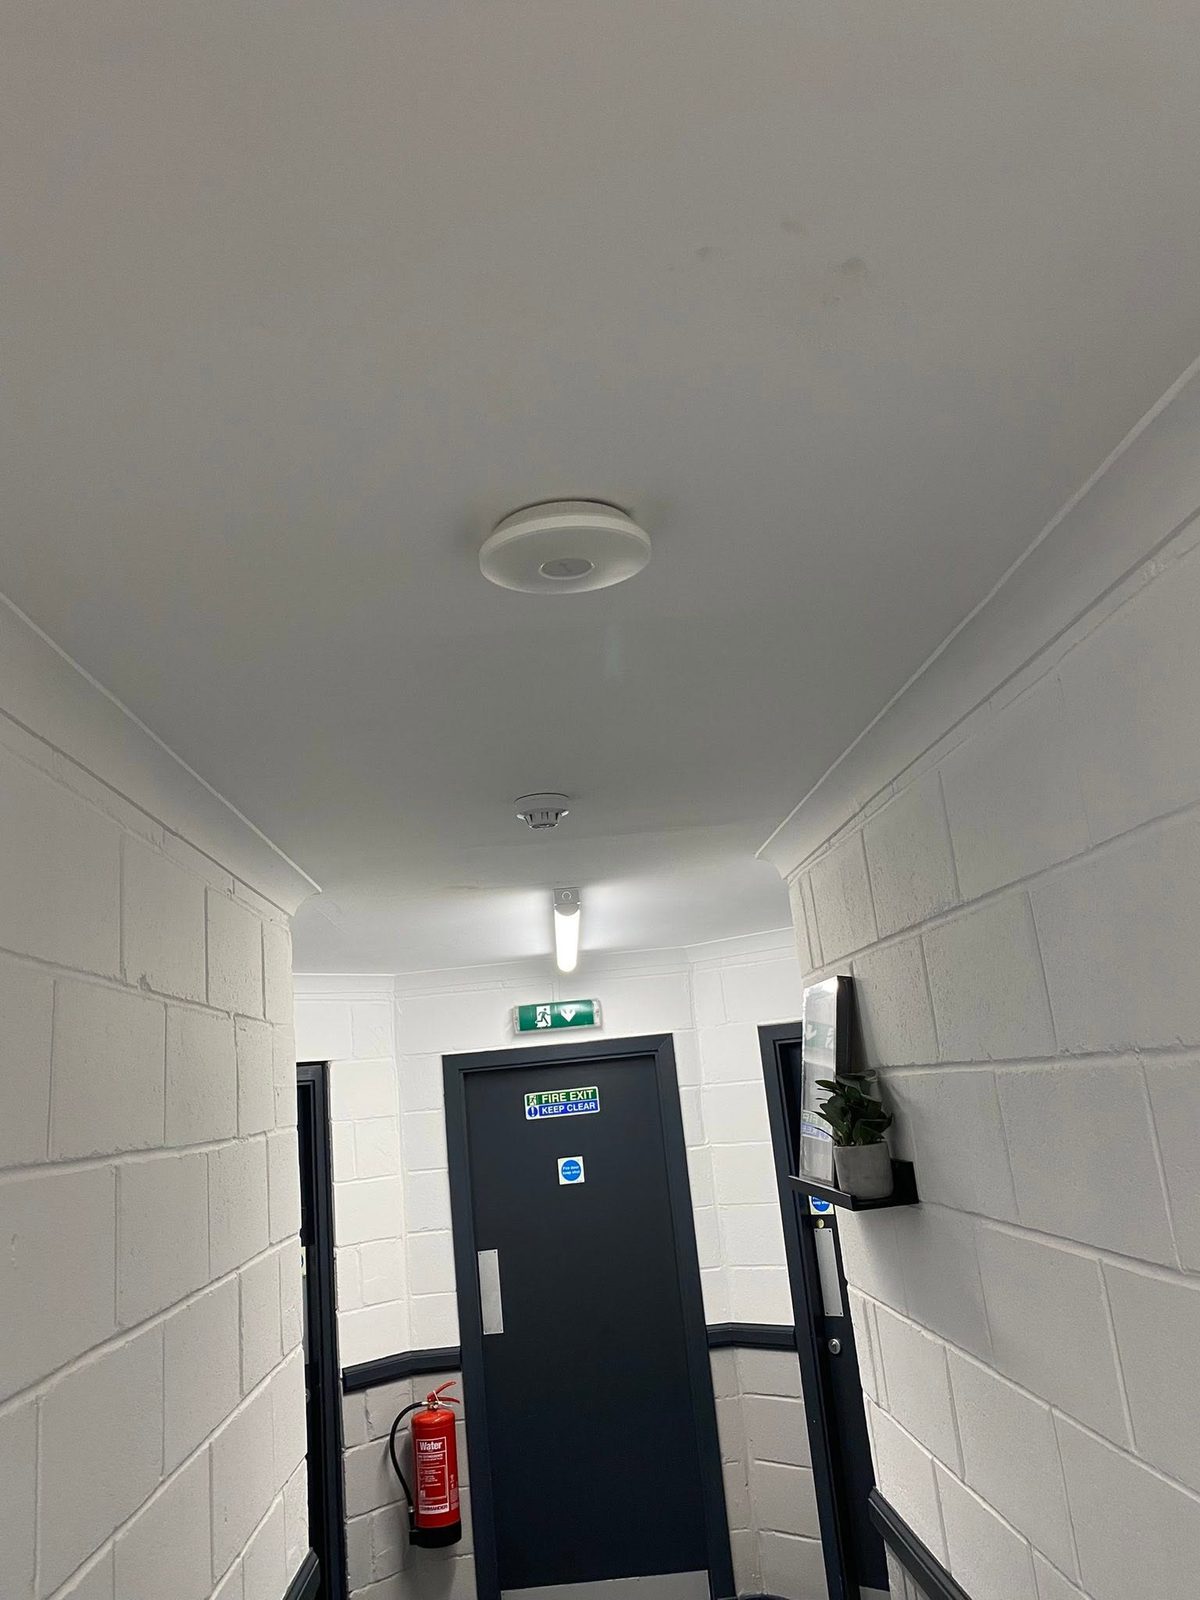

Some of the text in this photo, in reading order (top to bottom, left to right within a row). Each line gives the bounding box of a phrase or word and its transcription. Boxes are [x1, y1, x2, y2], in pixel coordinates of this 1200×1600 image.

[541, 1090, 594, 1104] FIRE EXIT
[541, 1102, 596, 1115] KEEP CLEAR
[419, 1441, 443, 1451] Water
